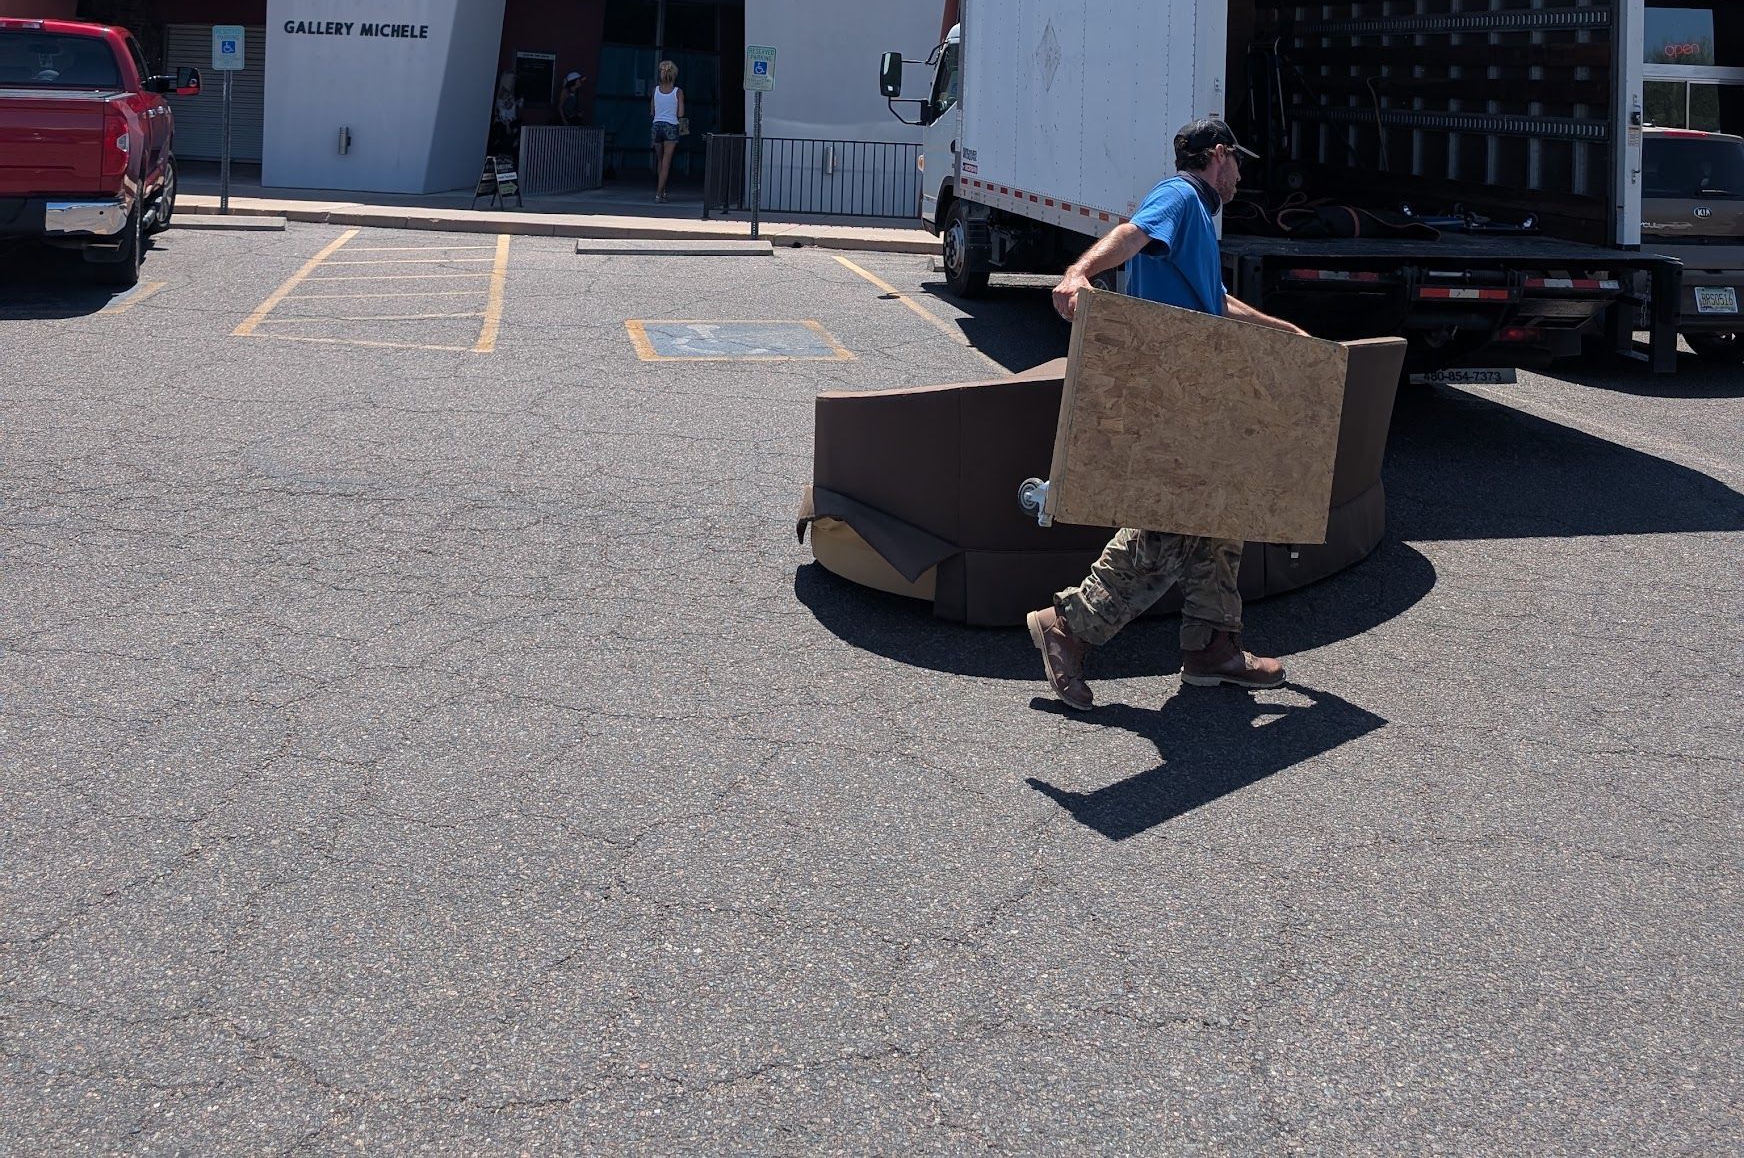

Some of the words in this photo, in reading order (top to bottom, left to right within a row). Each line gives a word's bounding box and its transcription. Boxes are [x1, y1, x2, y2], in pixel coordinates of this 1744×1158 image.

[284, 20, 354, 36] GALLERY
[360, 23, 429, 39] MICHELE
[1665, 44, 1699, 58] open
[1697, 208, 1711, 217] KIA
[1424, 371, 1502, 382] 480-854-7373
